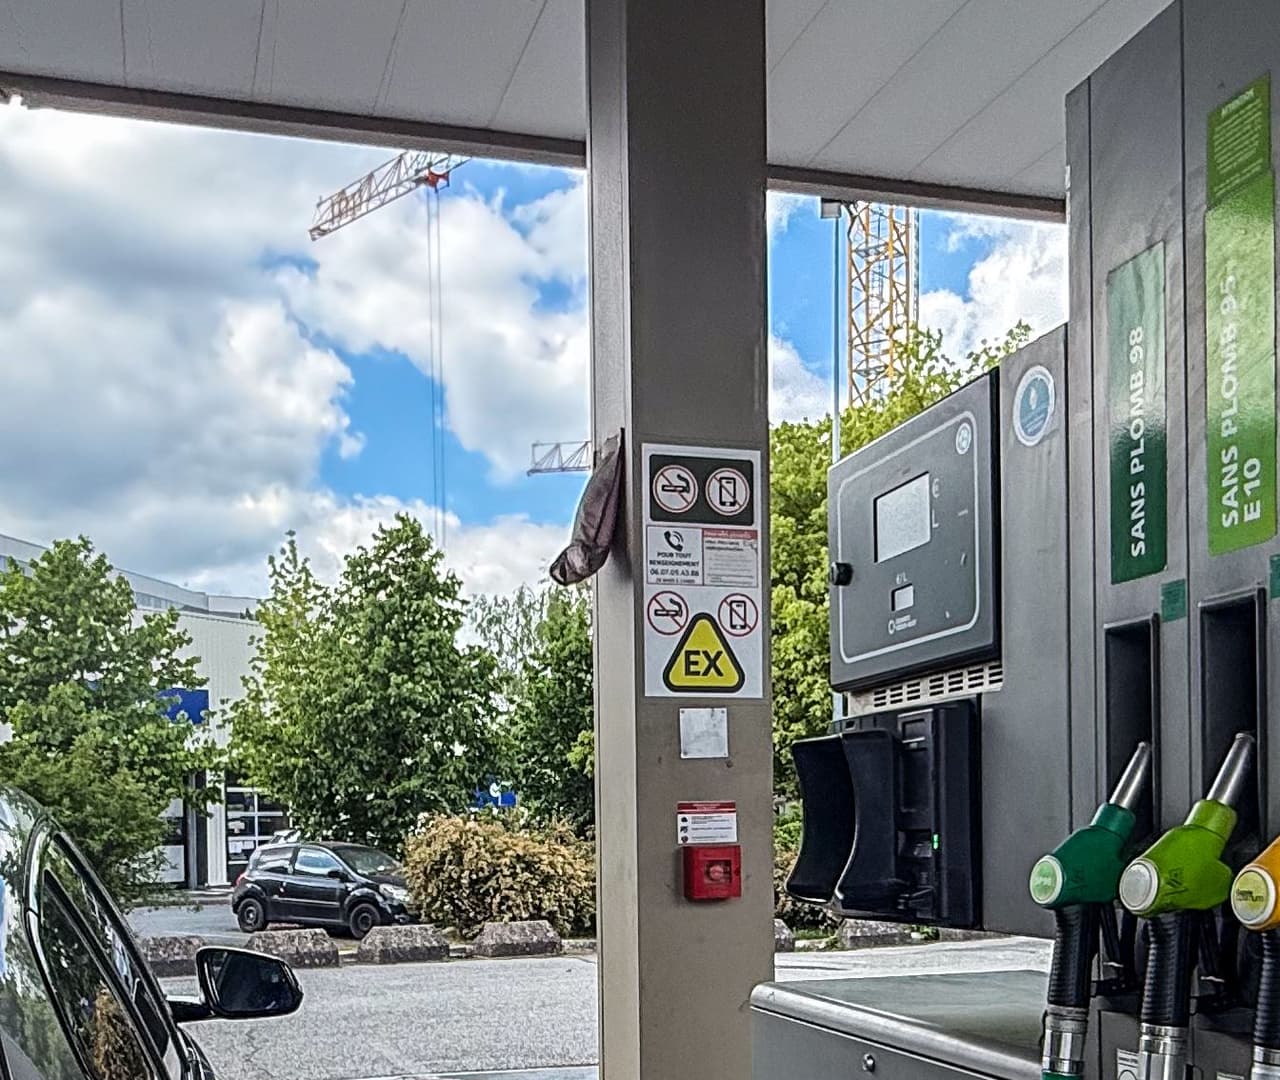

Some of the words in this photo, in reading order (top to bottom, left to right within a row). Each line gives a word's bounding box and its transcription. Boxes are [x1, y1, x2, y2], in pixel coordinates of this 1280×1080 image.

[1221, 275, 1237, 315] 95
[1129, 326, 1144, 364] 98
[1221, 323, 1239, 437] PLOMB
[1130, 369, 1146, 475] PLOMB
[1131, 481, 1146, 558] SANS
[1221, 446, 1239, 528] SANS
[684, 650, 724, 677] EX
